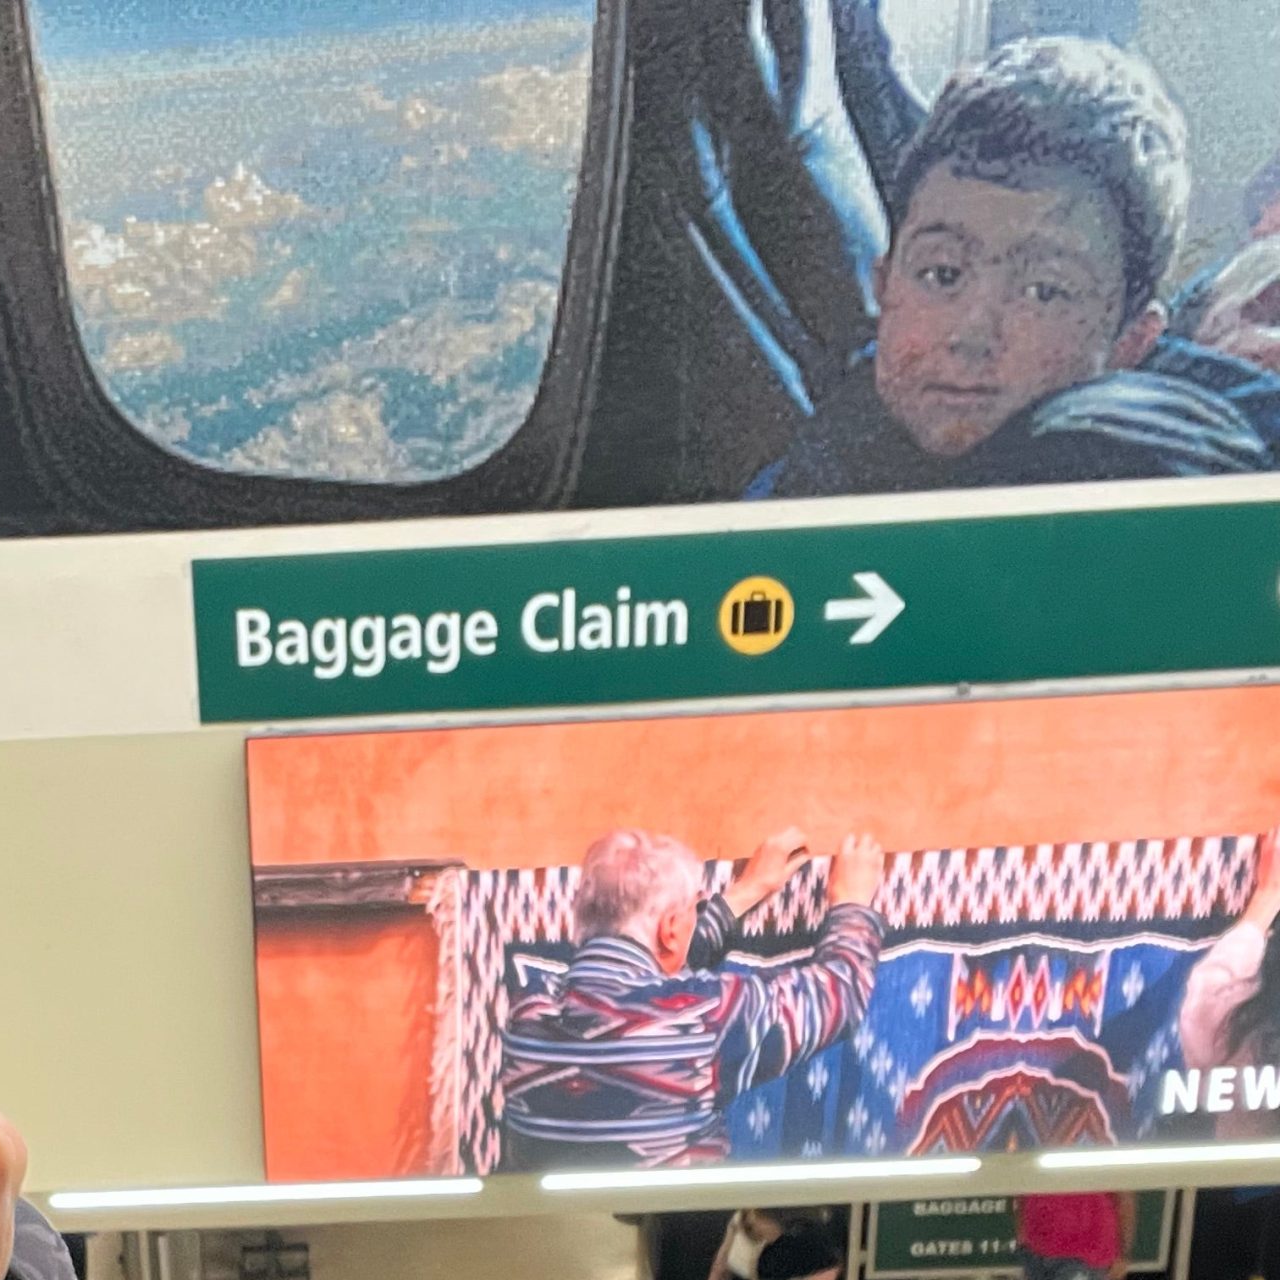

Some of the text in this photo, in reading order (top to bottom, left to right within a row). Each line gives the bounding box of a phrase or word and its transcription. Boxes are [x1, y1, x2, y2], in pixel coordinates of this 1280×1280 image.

[235, 586, 689, 679] Baggage Claim
[1161, 1064, 1280, 1115] NEW
[913, 1199, 1006, 1216] BAGGAGE
[910, 1239, 973, 1257] GATES
